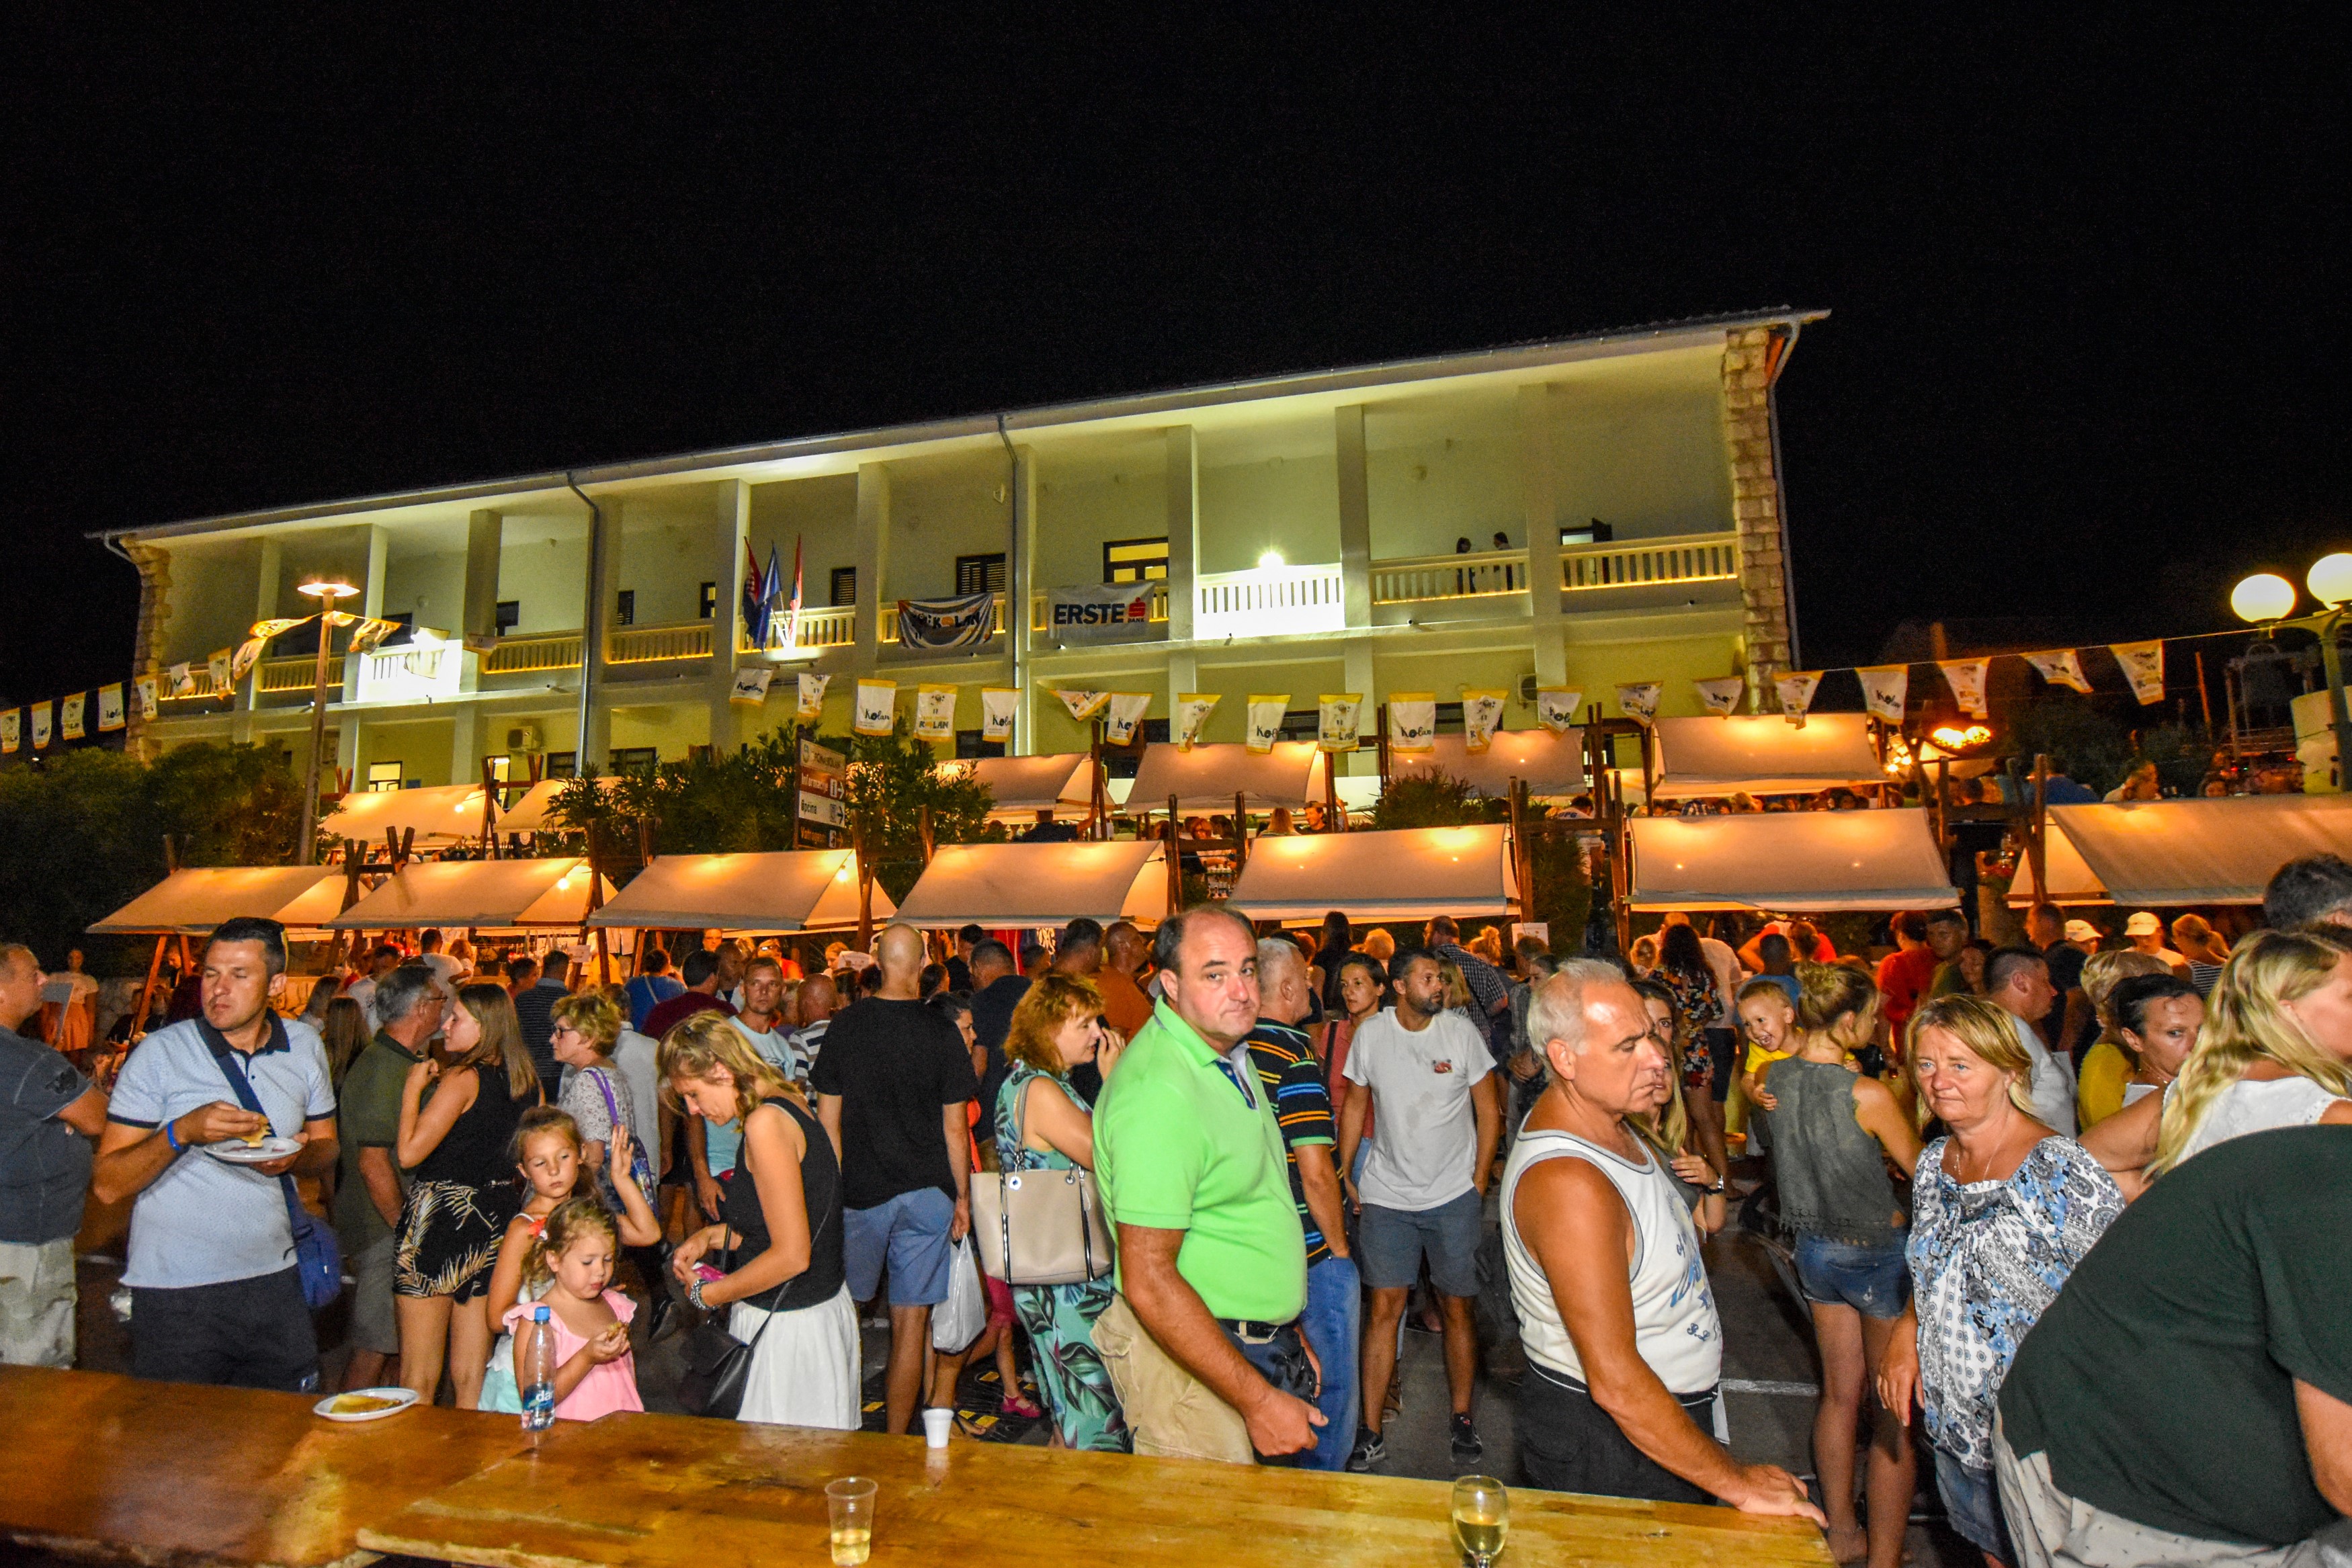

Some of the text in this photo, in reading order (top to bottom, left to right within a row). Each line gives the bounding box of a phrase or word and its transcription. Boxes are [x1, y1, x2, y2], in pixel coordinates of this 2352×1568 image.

[1054, 603, 1125, 624] ERSTE
[865, 708, 890, 720] Kolan
[1401, 726, 1431, 738] Kolan
